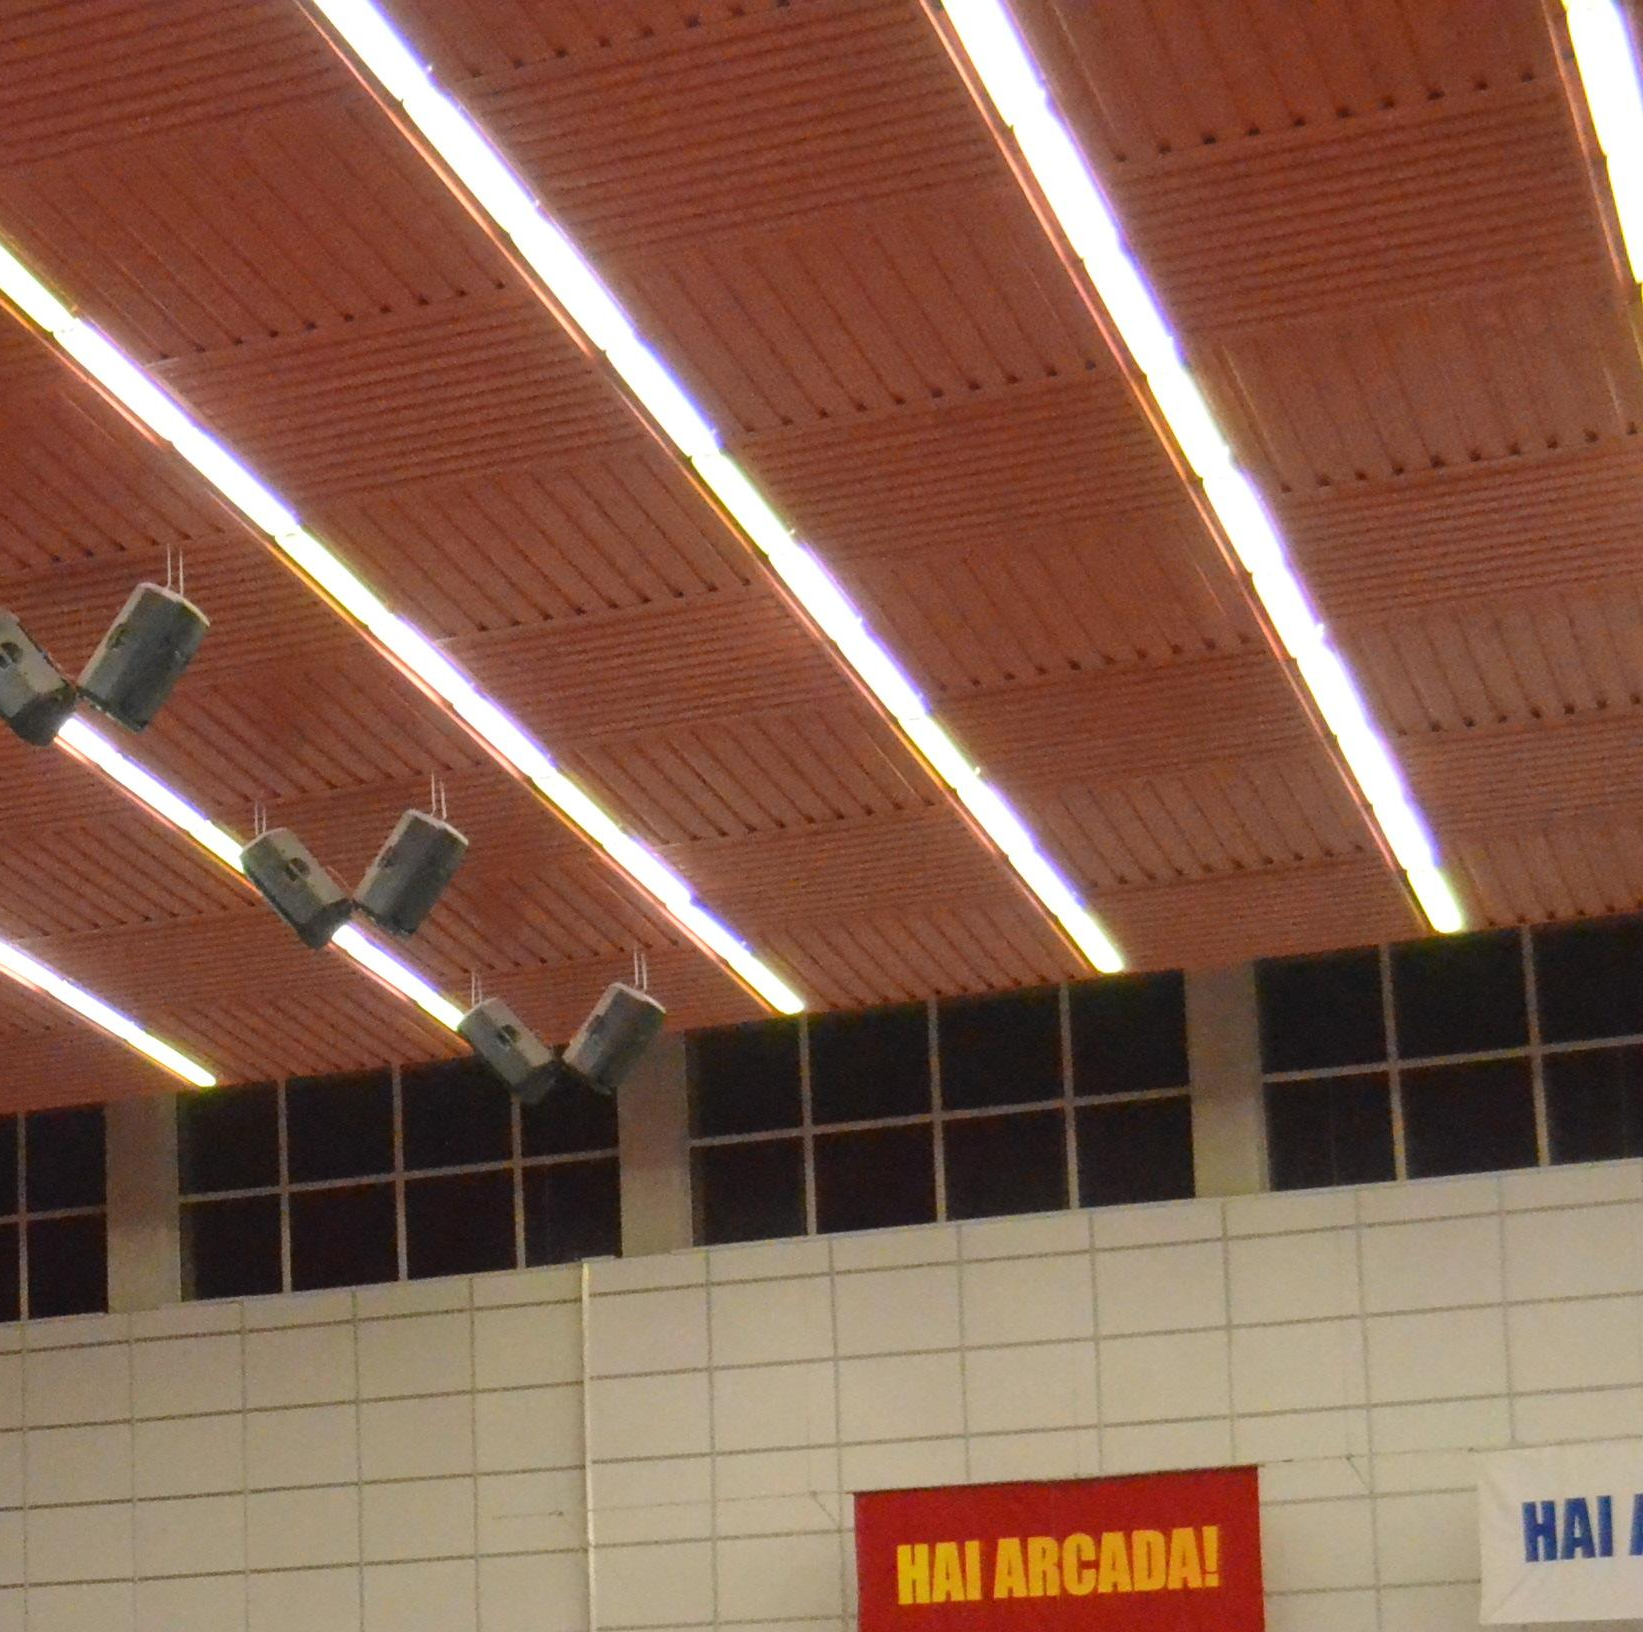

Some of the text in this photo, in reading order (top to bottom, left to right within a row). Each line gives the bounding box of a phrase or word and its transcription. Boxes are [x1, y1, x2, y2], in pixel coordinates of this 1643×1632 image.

[897, 1525, 1219, 1605] HAI ARCADA!
[1522, 1495, 1613, 1562] HAI
